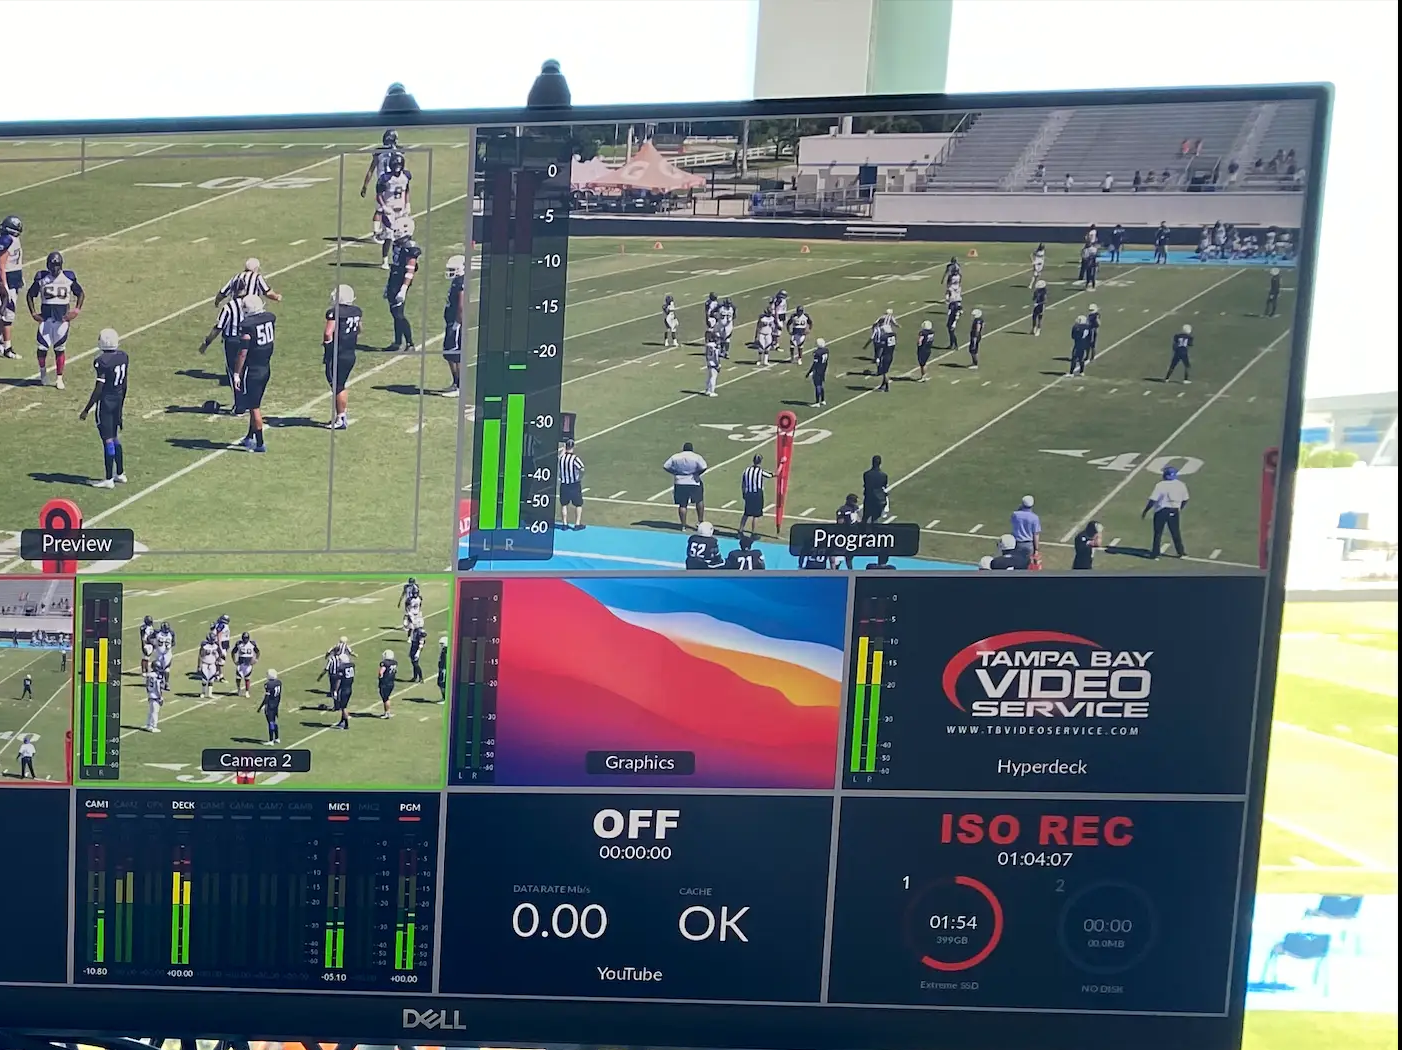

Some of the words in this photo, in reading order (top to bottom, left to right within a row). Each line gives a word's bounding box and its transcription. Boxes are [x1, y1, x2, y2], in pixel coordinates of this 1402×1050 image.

[547, 164, 557, 177] 0
[42, 535, 112, 553] Preview
[814, 529, 895, 551] Program
[976, 651, 1081, 667] TAMPA
[1091, 651, 1154, 667] BAY
[975, 669, 1151, 699] VIDEO
[972, 701, 1149, 718] SERVICE
[946, 725, 1139, 736] WWW.TBVIDEOSERVICE.COM
[220, 754, 277, 767] Camera
[282, 754, 292, 767] 2
[605, 755, 675, 773] Graphics
[998, 759, 1087, 777] Hyperdeck
[85, 800, 109, 809] CAM1
[172, 801, 196, 810] DECK
[328, 802, 350, 812] MIC1
[400, 803, 421, 812] PGM
[593, 808, 680, 840] OFF
[941, 813, 1020, 845] ISO
[1038, 814, 1134, 847] REC
[599, 845, 672, 860] 00:00:00
[997, 852, 1073, 867] 01:04:07
[902, 876, 910, 890] 1
[679, 887, 712, 897] CACHE
[512, 902, 608, 939] 0.00
[678, 905, 750, 943] OK
[929, 915, 978, 930] 01:54
[936, 935, 968, 946] 399GB
[167, 968, 194, 978] +00.00
[321, 972, 347, 982] -05.10
[390, 974, 418, 984] +00.00
[597, 966, 663, 982] YouTube
[920, 980, 957, 990] Extreme
[960, 981, 979, 990] SSD
[403, 1009, 466, 1029] DELL
